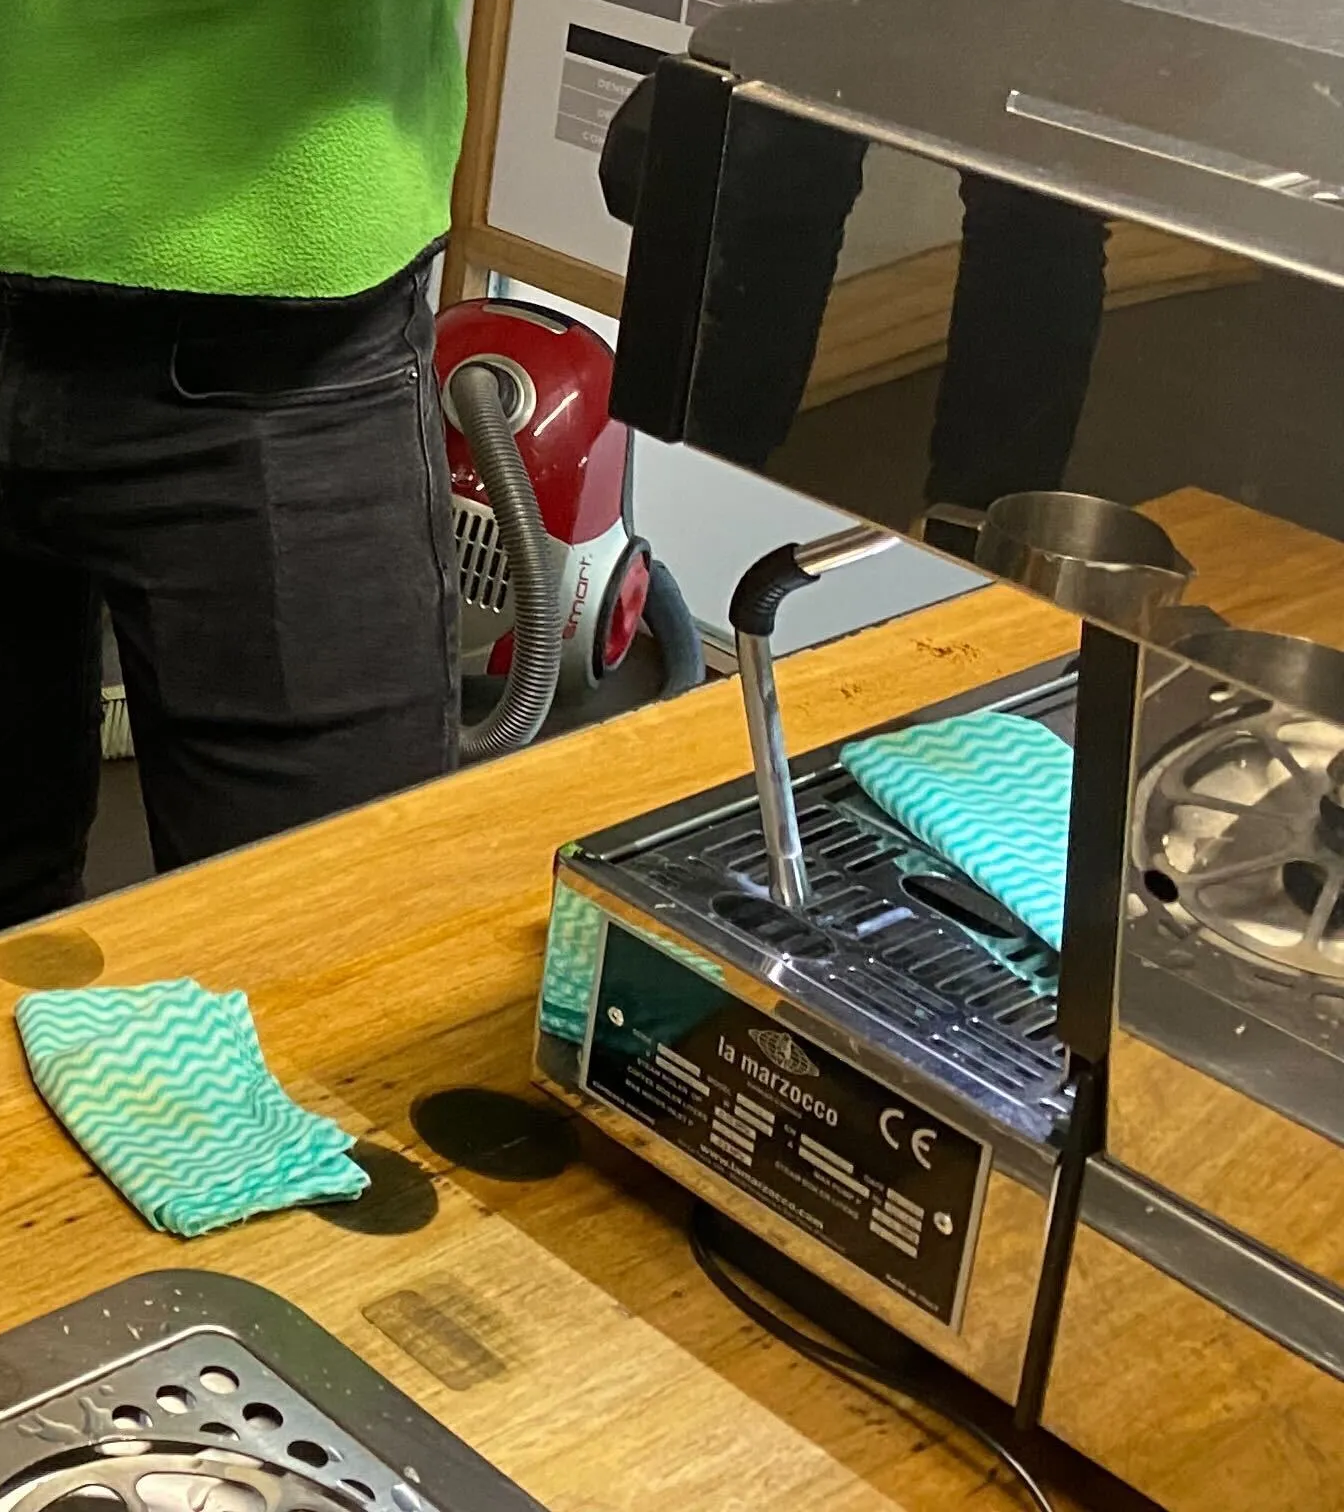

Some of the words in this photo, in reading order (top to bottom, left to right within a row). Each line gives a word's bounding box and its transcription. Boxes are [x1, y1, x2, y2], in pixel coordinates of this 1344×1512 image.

[717, 1035, 736, 1066] la
[740, 1053, 840, 1128] marzocco
[879, 1107, 938, 1170] CE
